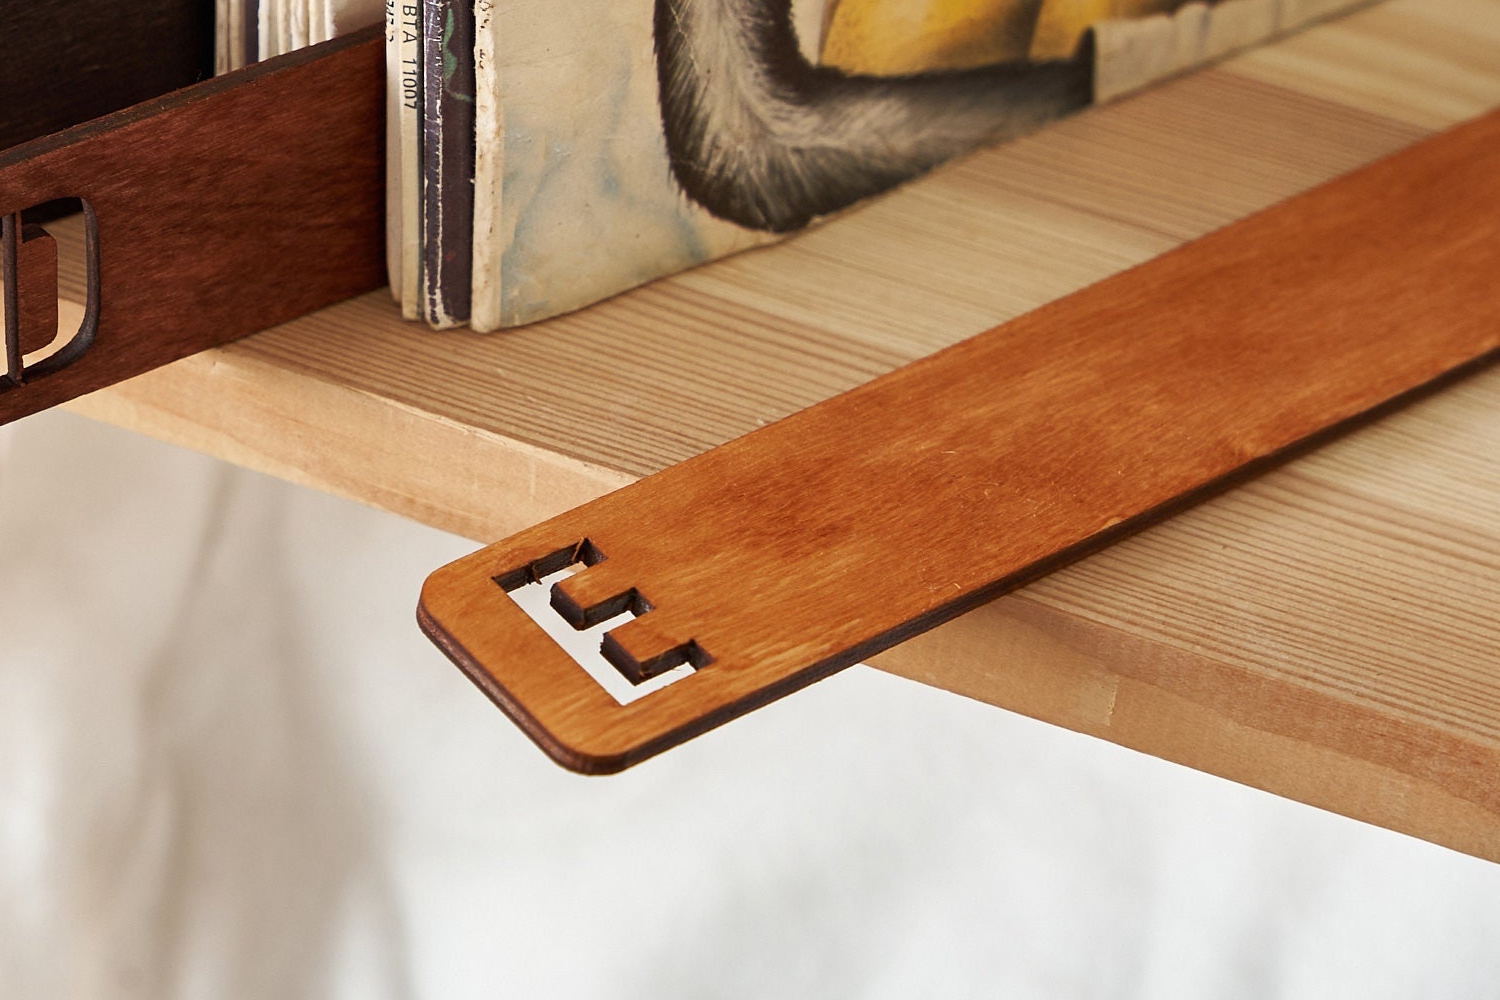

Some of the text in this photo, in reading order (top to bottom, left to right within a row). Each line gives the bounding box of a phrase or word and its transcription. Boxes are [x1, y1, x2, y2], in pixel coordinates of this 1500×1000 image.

[402, 4, 418, 44] ВТА
[403, 58, 418, 110] 11007
[490, 537, 719, 706] E
